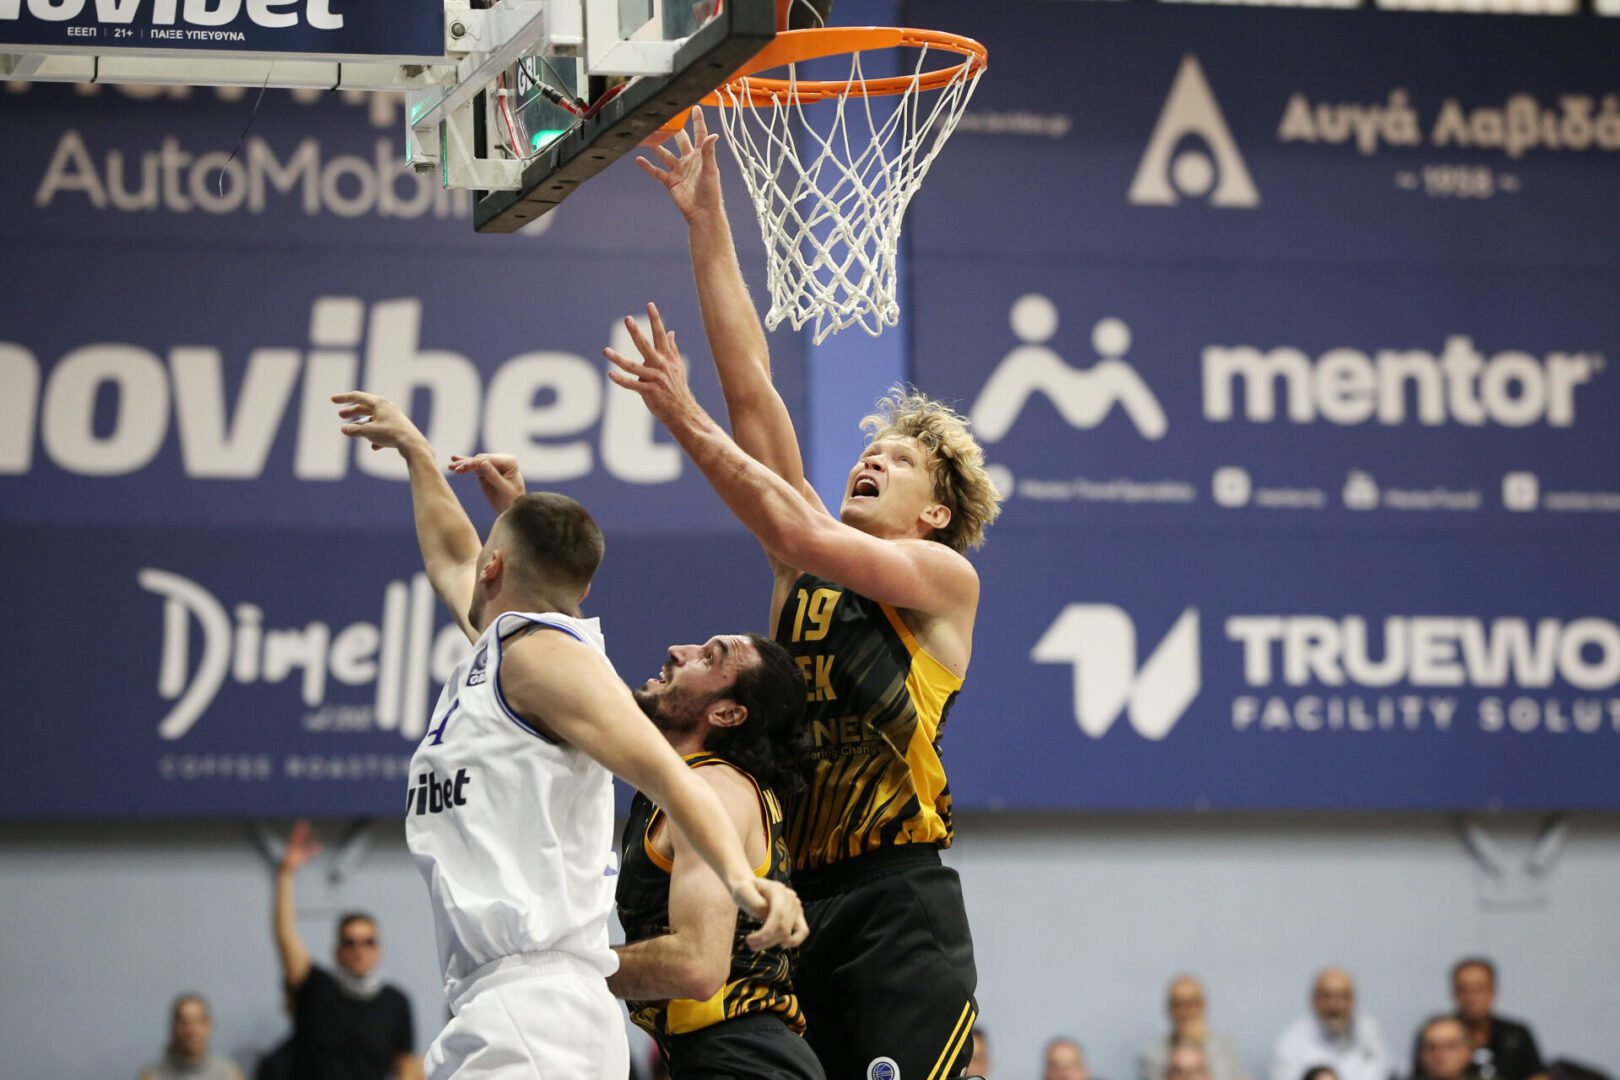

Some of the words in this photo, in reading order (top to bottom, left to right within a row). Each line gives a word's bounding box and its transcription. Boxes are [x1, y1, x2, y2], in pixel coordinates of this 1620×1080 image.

[114, 28, 133, 38] 21+
[150, 29, 183, 40] ΠΑΙΞΕ
[187, 30, 245, 41] ΥΠΕΥΘΥΝΑ
[1280, 89, 1419, 153] Αυγά
[1202, 333, 1590, 427] mentor
[791, 588, 842, 642] 19
[1231, 695, 1457, 731] FACILITY
